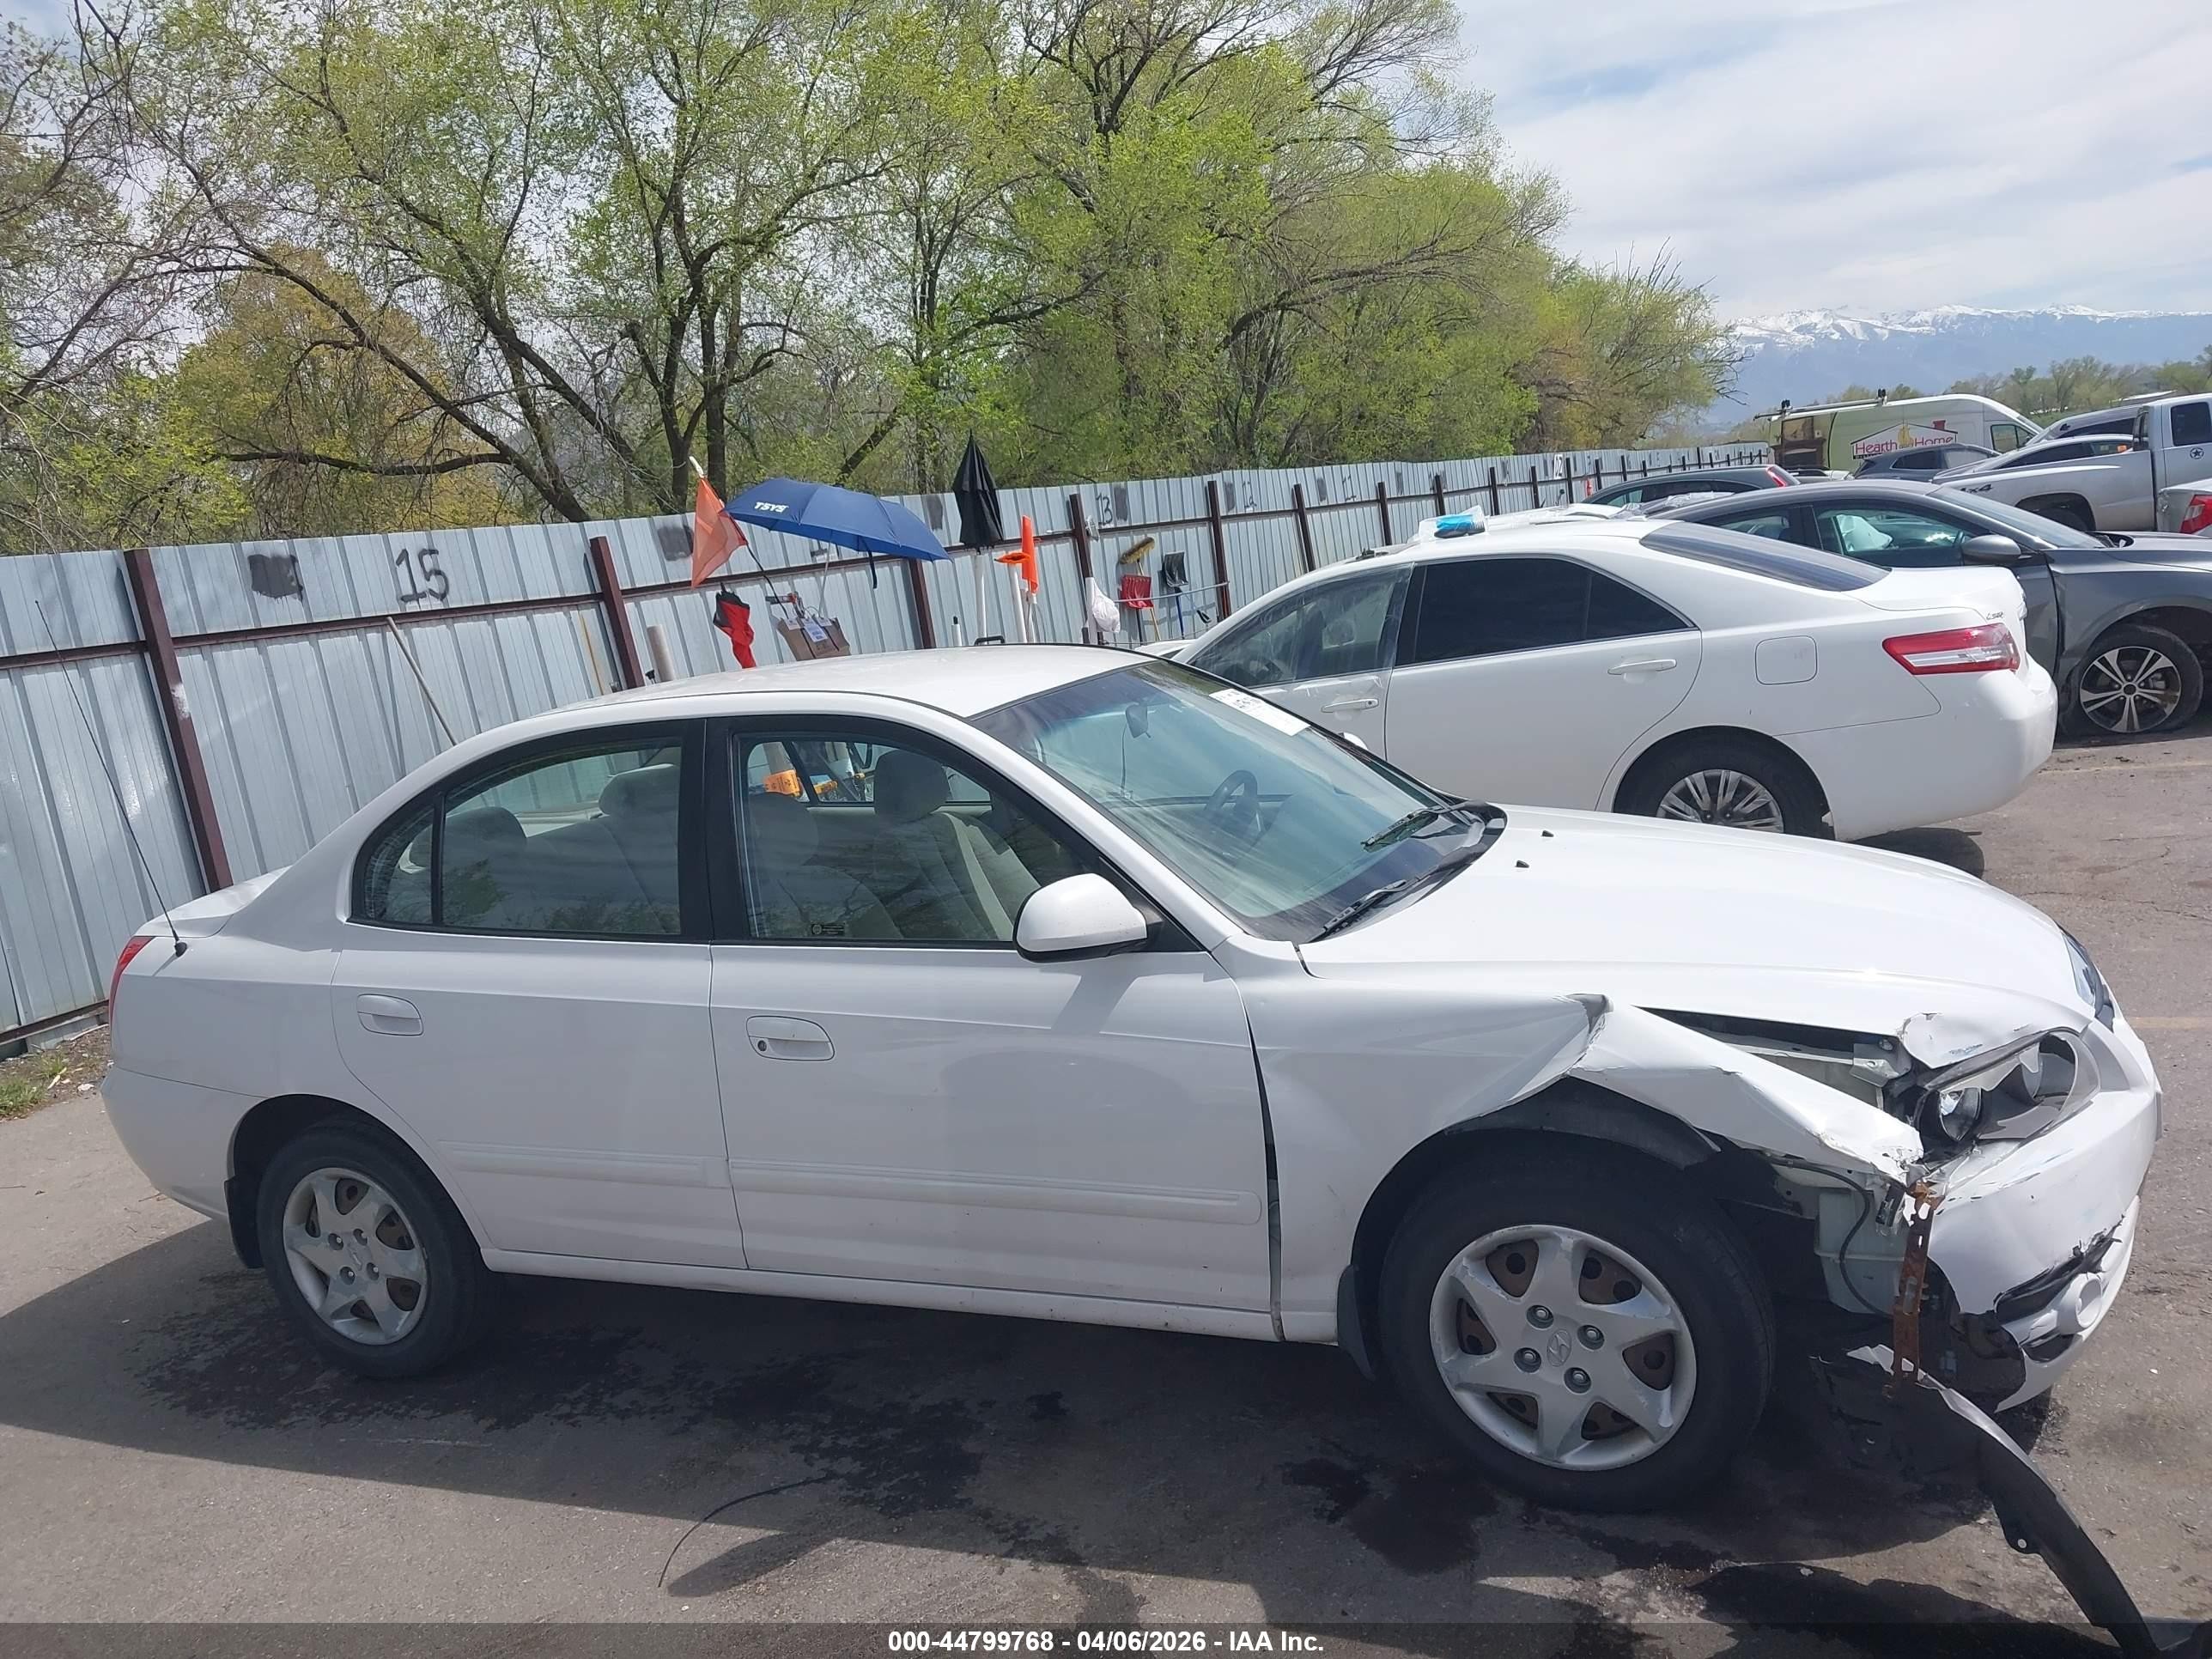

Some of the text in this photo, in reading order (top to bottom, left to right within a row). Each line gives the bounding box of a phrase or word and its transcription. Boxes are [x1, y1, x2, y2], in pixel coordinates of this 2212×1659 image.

[1855, 436, 1954, 454] Hearth Home
[755, 501, 789, 513] TSYS
[1096, 493, 1113, 526] 13
[396, 548, 449, 603] 15
